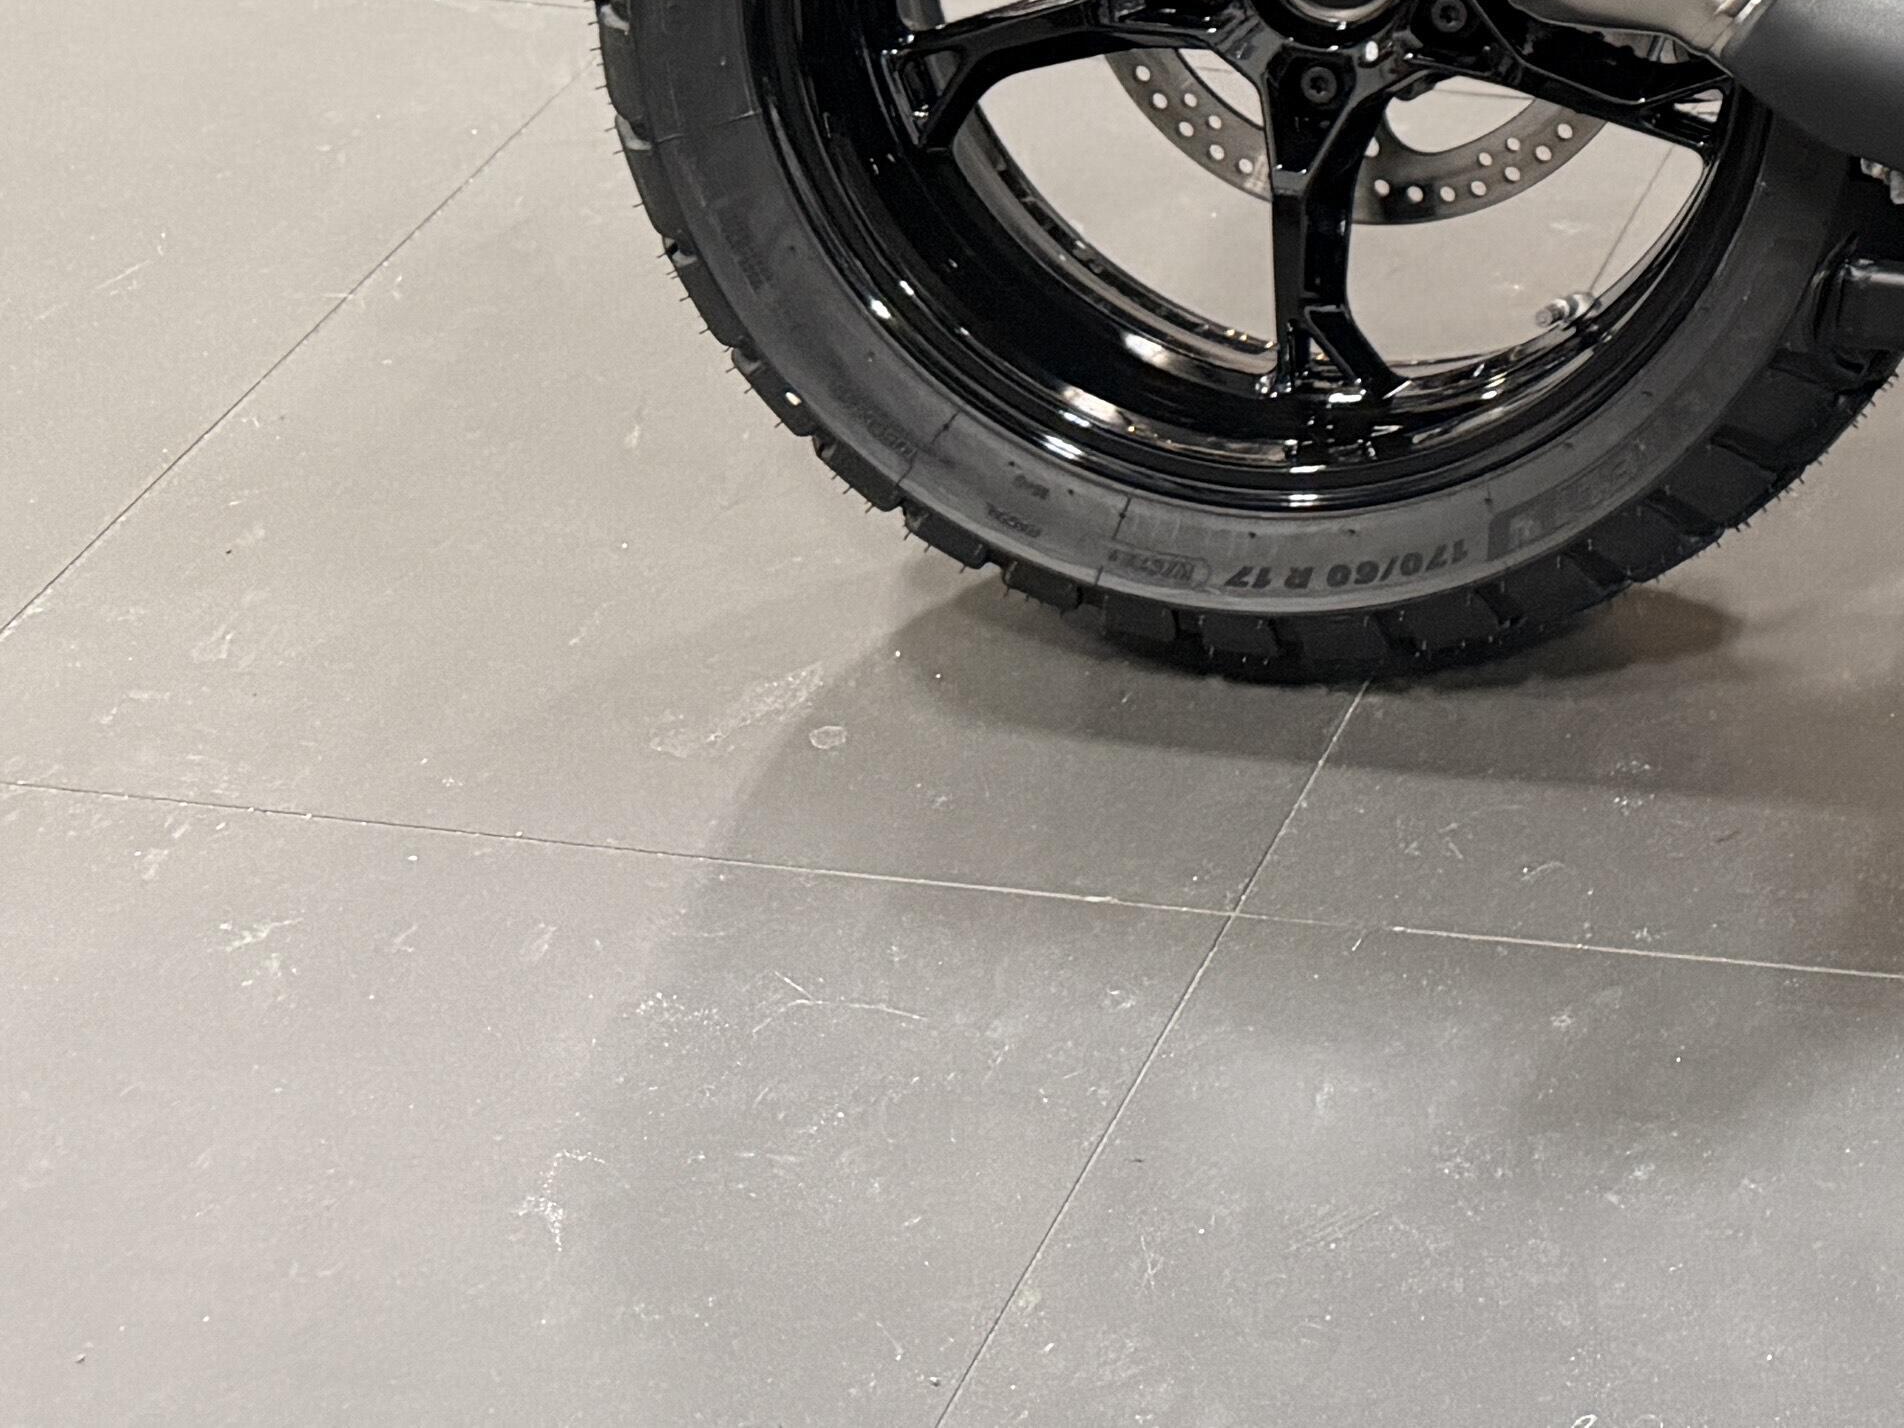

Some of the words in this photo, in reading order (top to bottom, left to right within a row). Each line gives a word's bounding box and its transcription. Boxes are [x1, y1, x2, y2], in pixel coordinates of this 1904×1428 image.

[1283, 563, 1314, 590] R
[1325, 537, 1470, 590] 170/60
[1223, 564, 1273, 591] 17
